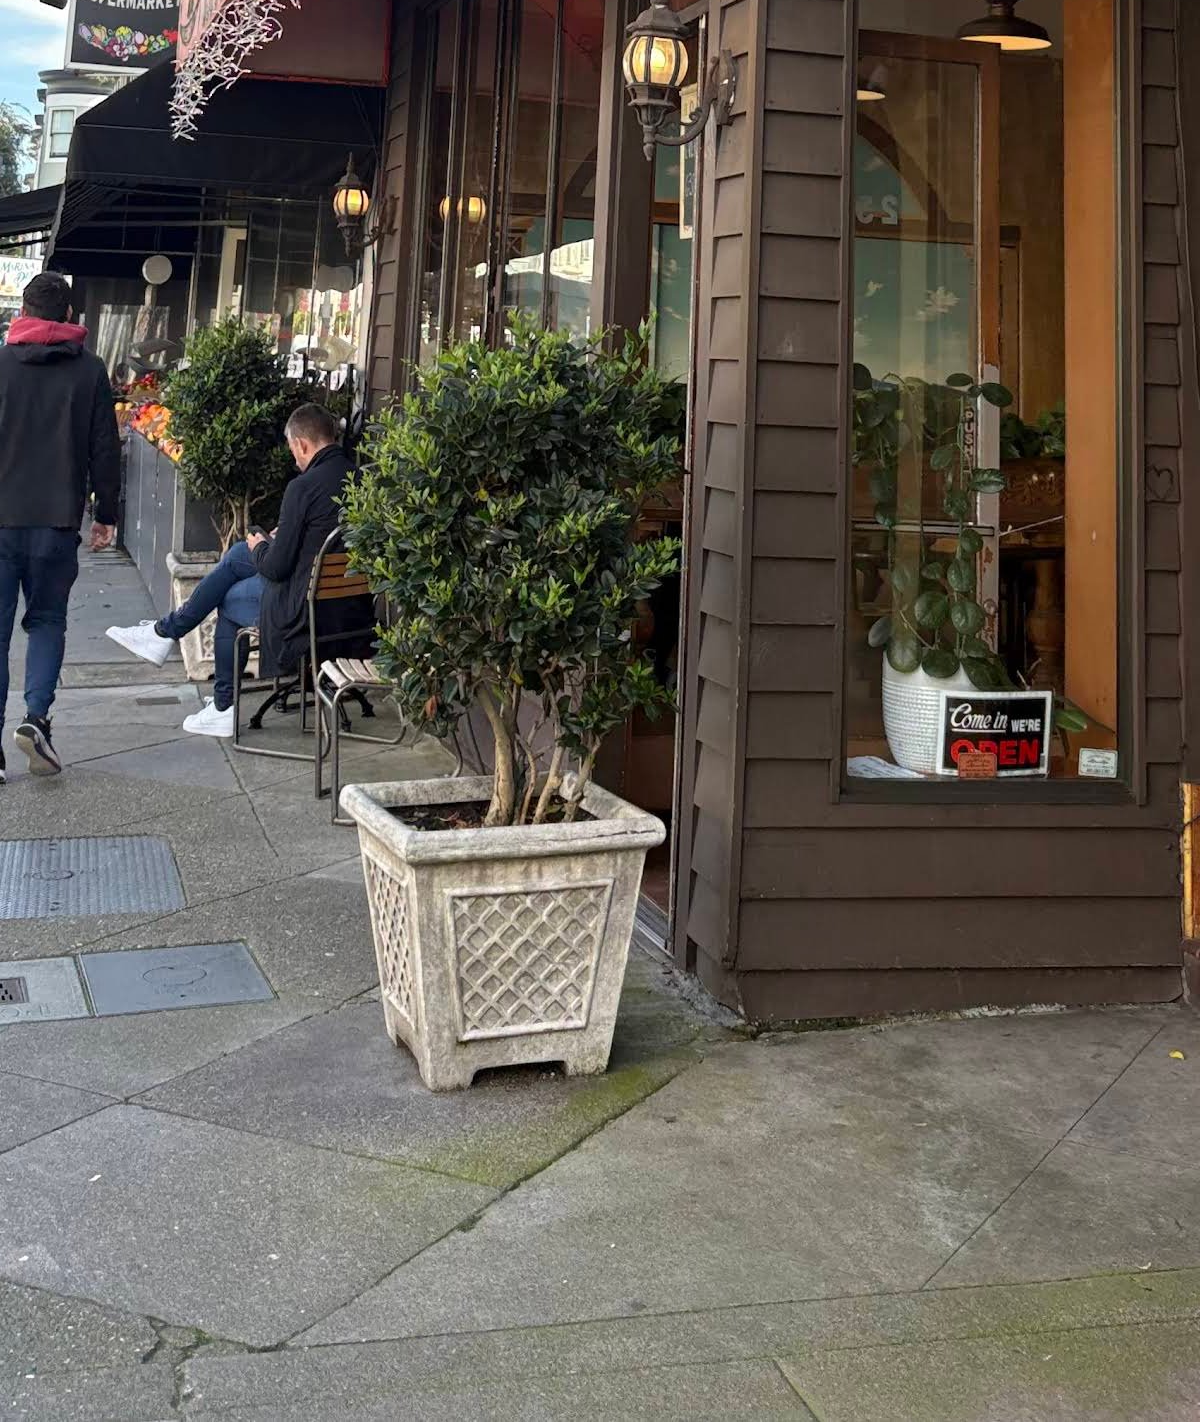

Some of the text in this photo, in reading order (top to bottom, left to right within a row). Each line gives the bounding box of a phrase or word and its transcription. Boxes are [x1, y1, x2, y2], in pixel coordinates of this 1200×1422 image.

[964, 410, 974, 456] PUSH
[950, 703, 1041, 732] Come in WE'RE
